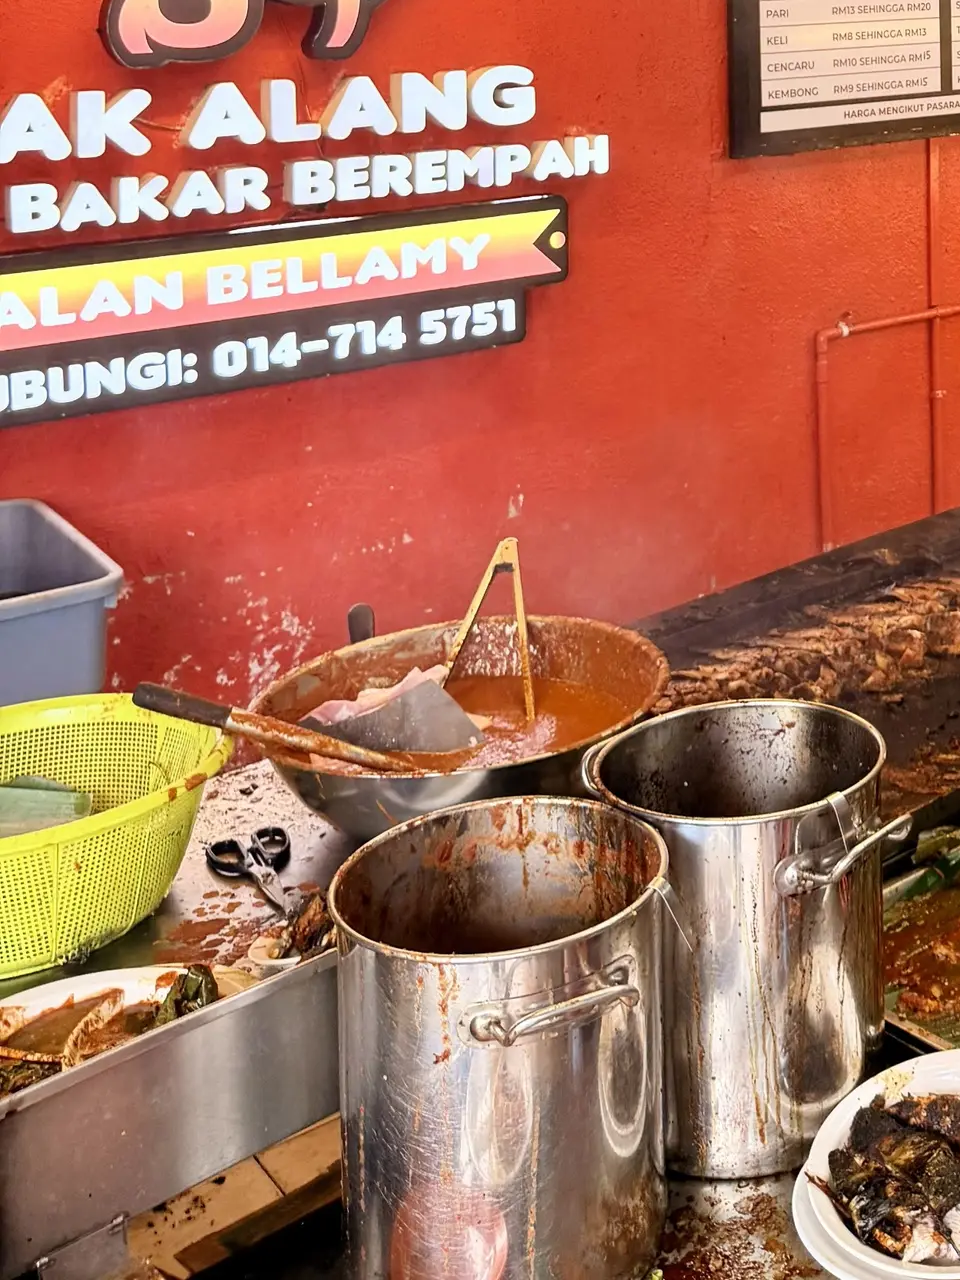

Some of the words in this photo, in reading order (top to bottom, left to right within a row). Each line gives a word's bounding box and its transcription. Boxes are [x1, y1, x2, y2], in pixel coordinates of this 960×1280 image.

[766, 9, 789, 19] PARI
[831, 5, 855, 16] RM13
[857, 3, 905, 14] SEHINGGA
[907, 2, 931, 12] RM20
[766, 35, 788, 45] KELI
[832, 32, 853, 41] RM8
[855, 30, 903, 40] SEHINGGA
[904, 28, 927, 37] RM13
[767, 61, 815, 72] CENCARU
[833, 58, 857, 68] RM10
[859, 55, 906, 66] SEHINGGA
[908, 50, 931, 62] RM15
[768, 87, 819, 99] KEMBONG
[833, 84, 854, 94] RM9
[856, 82, 904, 92] SEHINGGA
[905, 77, 928, 87] RM15
[0, 88, 152, 164] AK
[188, 65, 535, 150] ALANG
[843, 109, 876, 119] HARGA
[878, 104, 924, 116] MENGIKUT
[10, 166, 269, 234] BAKAR
[291, 134, 609, 206] BEREMPAH
[0, 271, 184, 330] ALAN
[206, 233, 491, 306] BELLAMY
[0, 348, 198, 411] BUNGI:
[213, 315, 406, 378] 014-714
[420, 298, 516, 346] 5751
